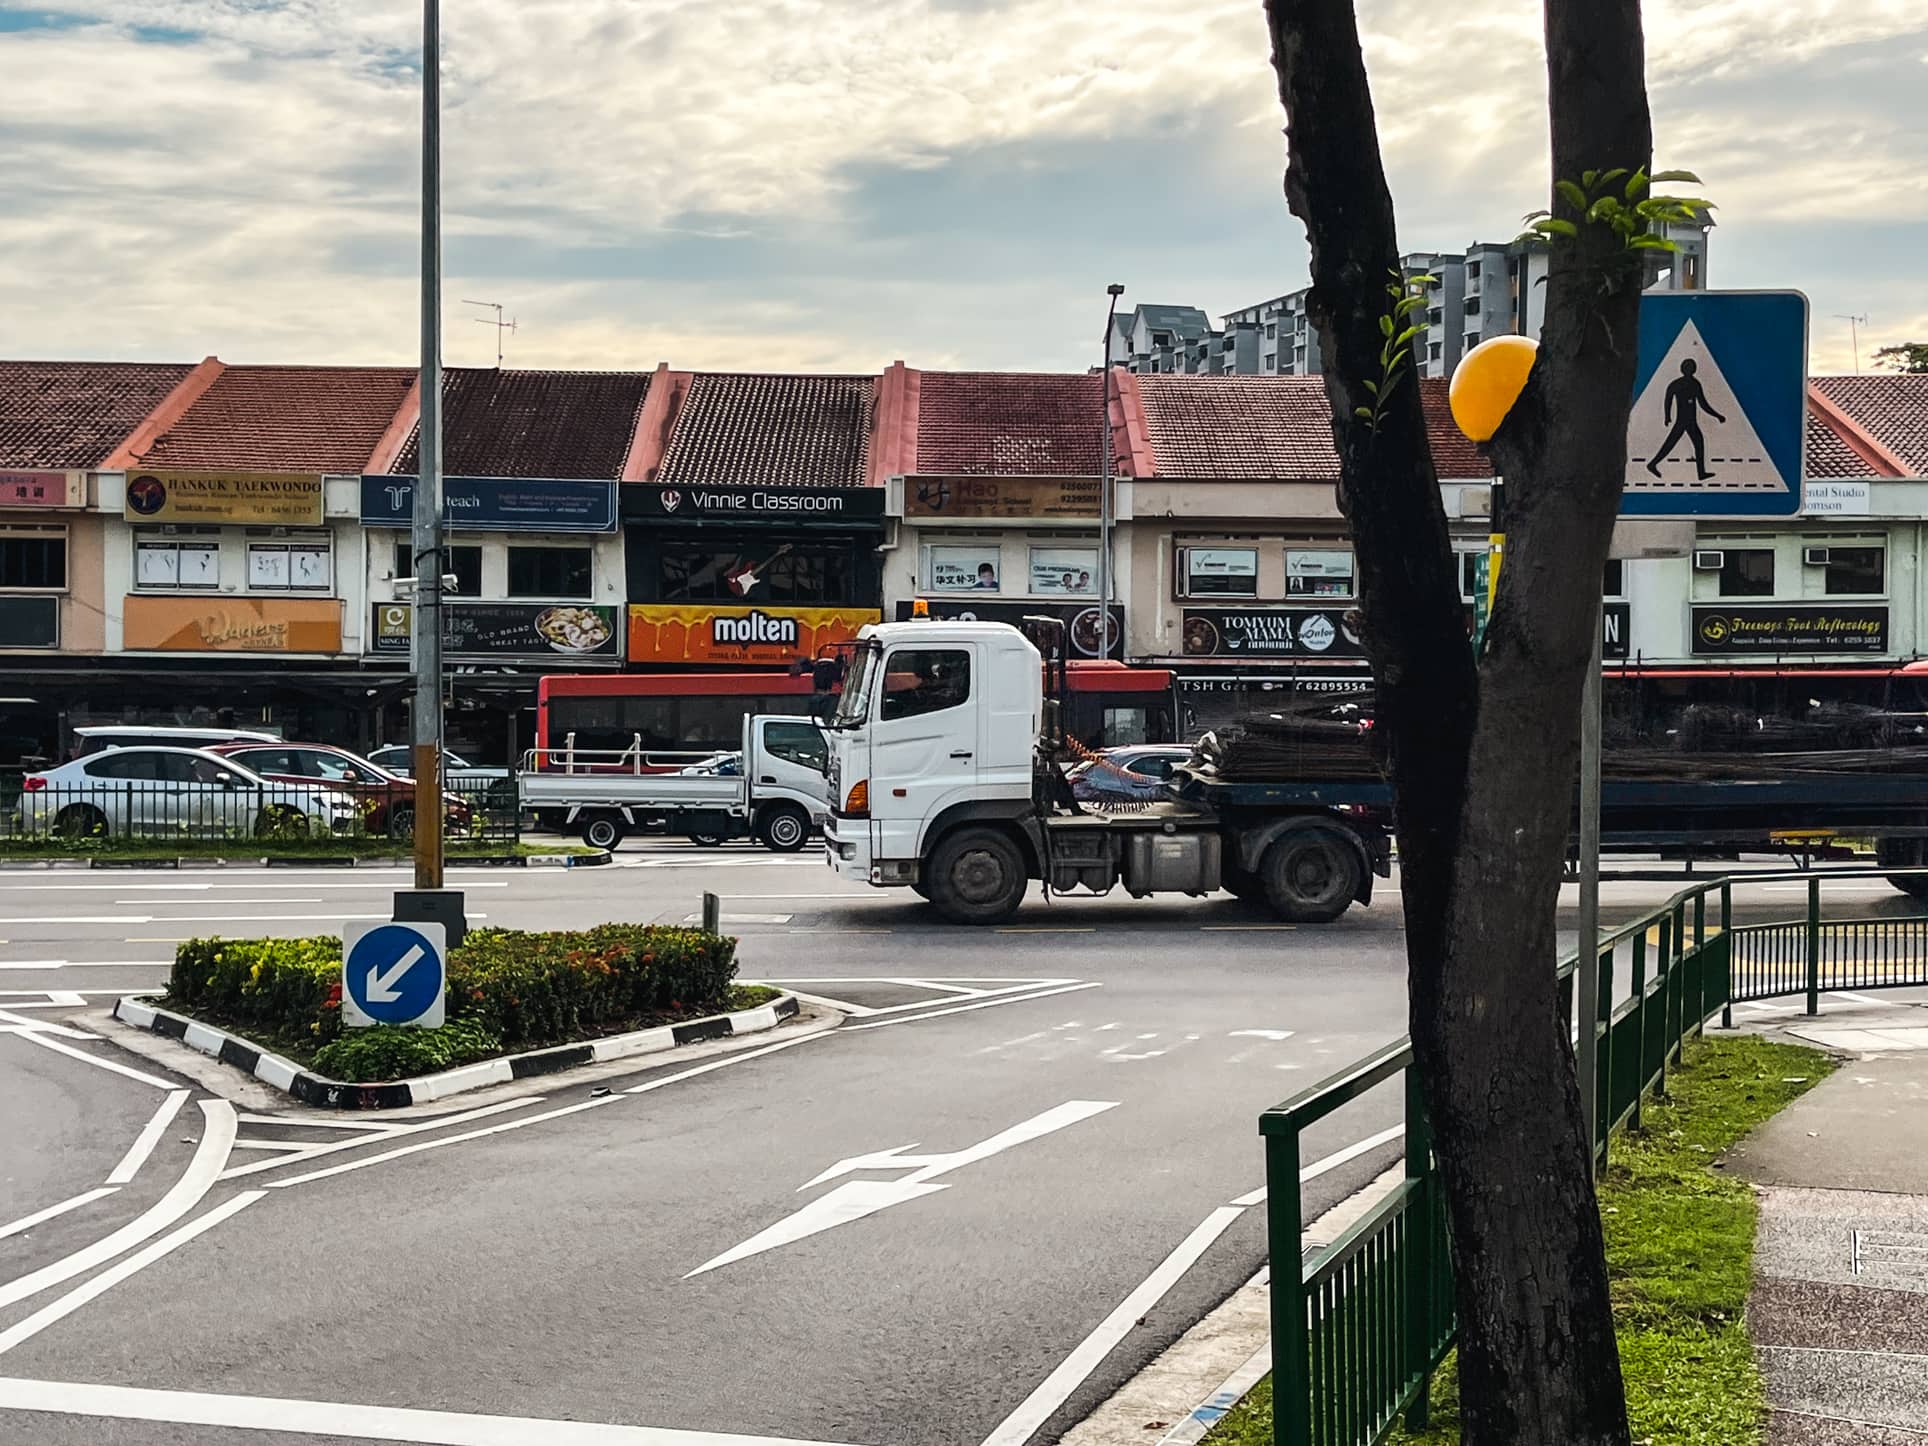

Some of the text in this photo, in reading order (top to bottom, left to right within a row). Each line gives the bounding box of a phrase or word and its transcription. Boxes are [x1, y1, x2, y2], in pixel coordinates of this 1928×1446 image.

[168, 479, 321, 494] HANKUK TAEKWONDO
[957, 479, 998, 497] Hao
[1831, 488, 1864, 497] Studio
[447, 494, 480, 508] teach
[692, 491, 842, 510] Vinnie Classroom
[714, 613, 795, 641] molten
[1222, 617, 1291, 628] TOMYUM
[1181, 681, 1213, 691] TSH
